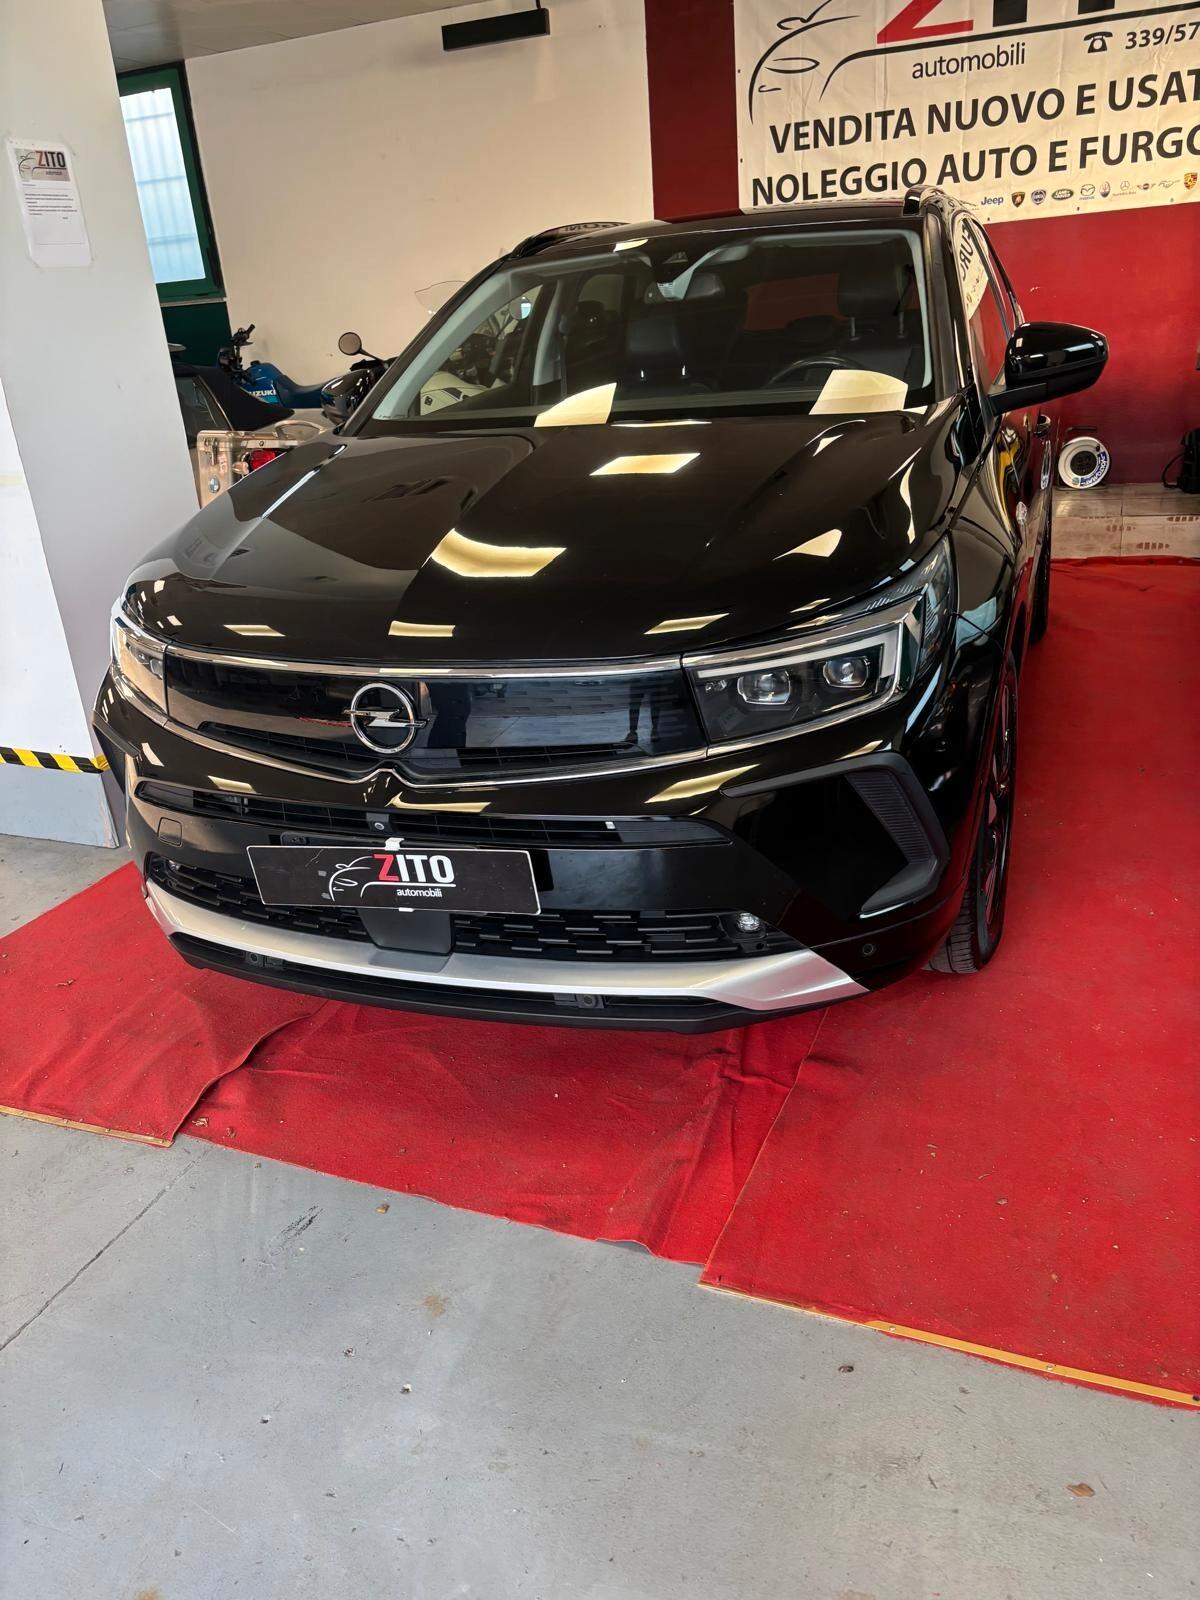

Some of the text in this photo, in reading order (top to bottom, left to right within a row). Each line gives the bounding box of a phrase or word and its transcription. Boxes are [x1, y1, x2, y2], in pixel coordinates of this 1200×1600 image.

[911, 41, 1026, 79] automobili
[769, 107, 917, 153] VENDITA
[927, 88, 1065, 135] NUOVO
[1076, 83, 1097, 116] E
[35, 150, 66, 168] ZITO
[752, 157, 927, 207] NOLEGGIO
[936, 144, 1038, 186] AUTO
[1048, 139, 1068, 173] E
[981, 196, 1004, 206] Jeep
[249, 389, 277, 397] UZUKI
[374, 853, 455, 883] ZITO
[396, 887, 443, 898] automobili
